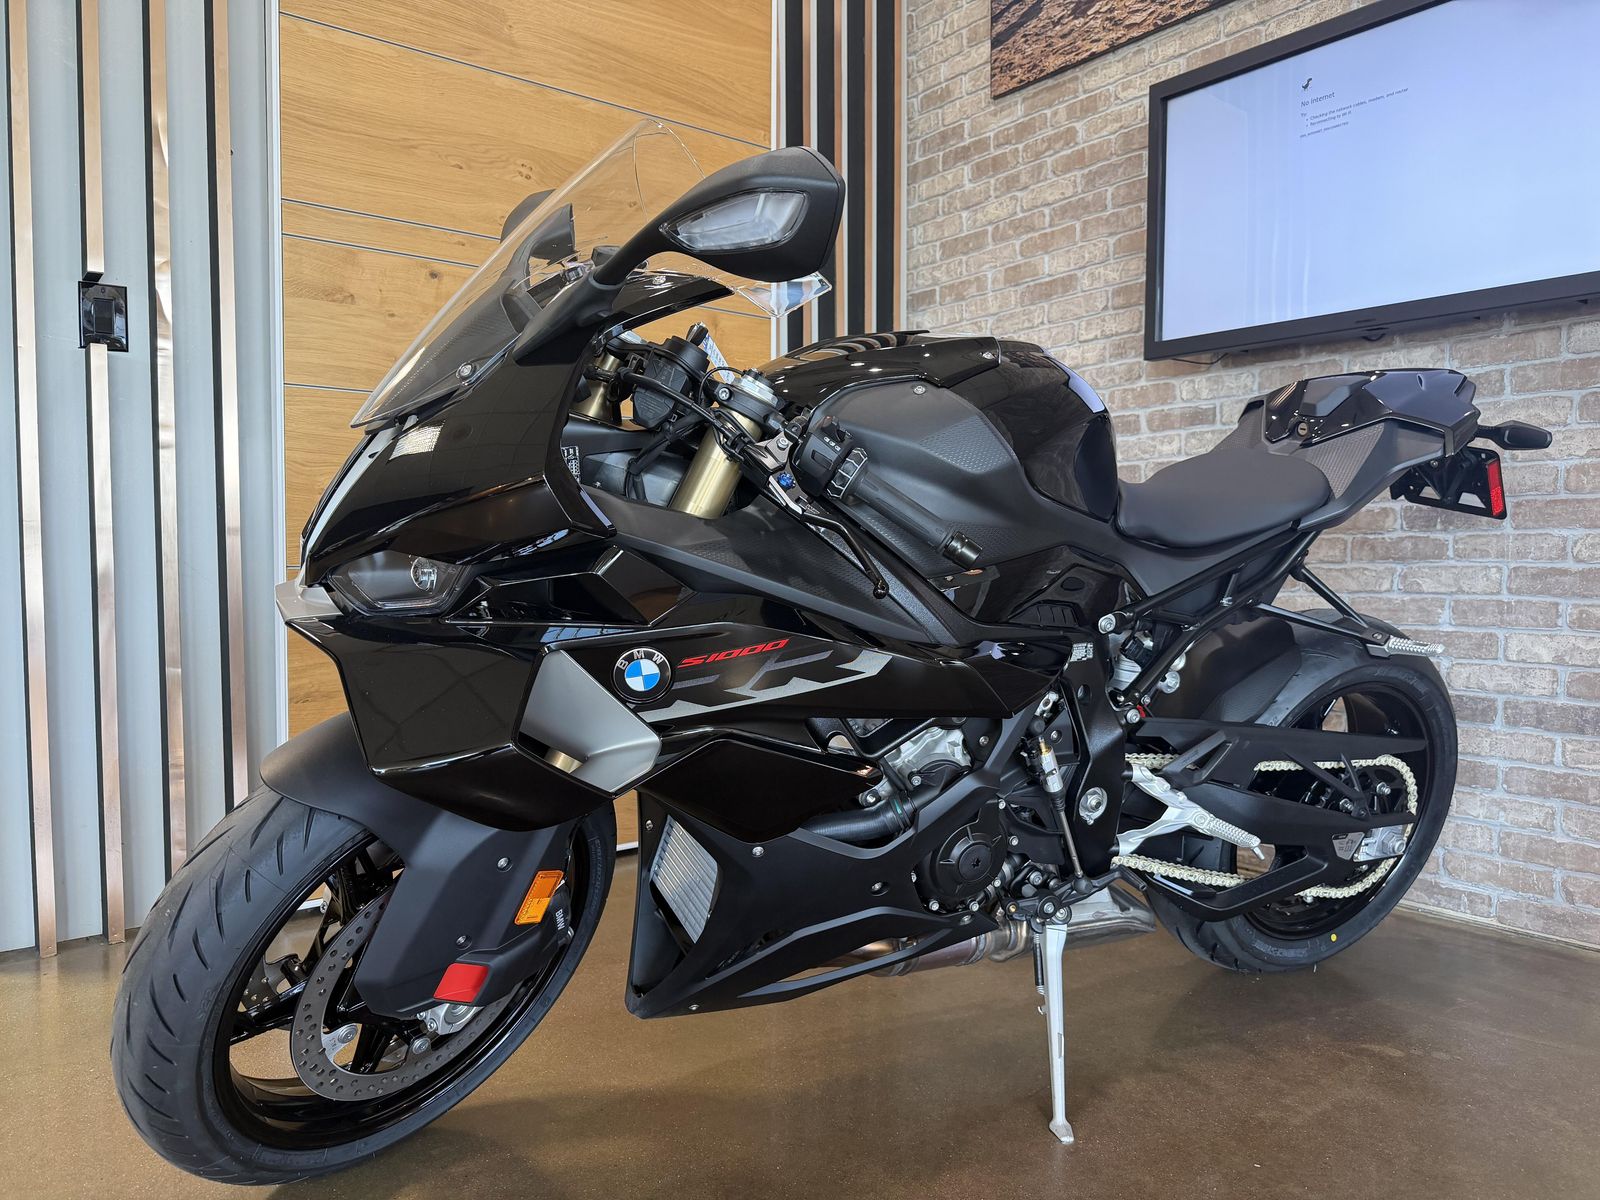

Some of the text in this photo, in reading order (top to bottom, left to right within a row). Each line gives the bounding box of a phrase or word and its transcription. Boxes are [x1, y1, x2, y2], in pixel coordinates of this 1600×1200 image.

[1301, 100, 1309, 108] No
[617, 649, 664, 670] BMW
[678, 638, 790, 668] S1000
[555, 908, 566, 931] BMW
